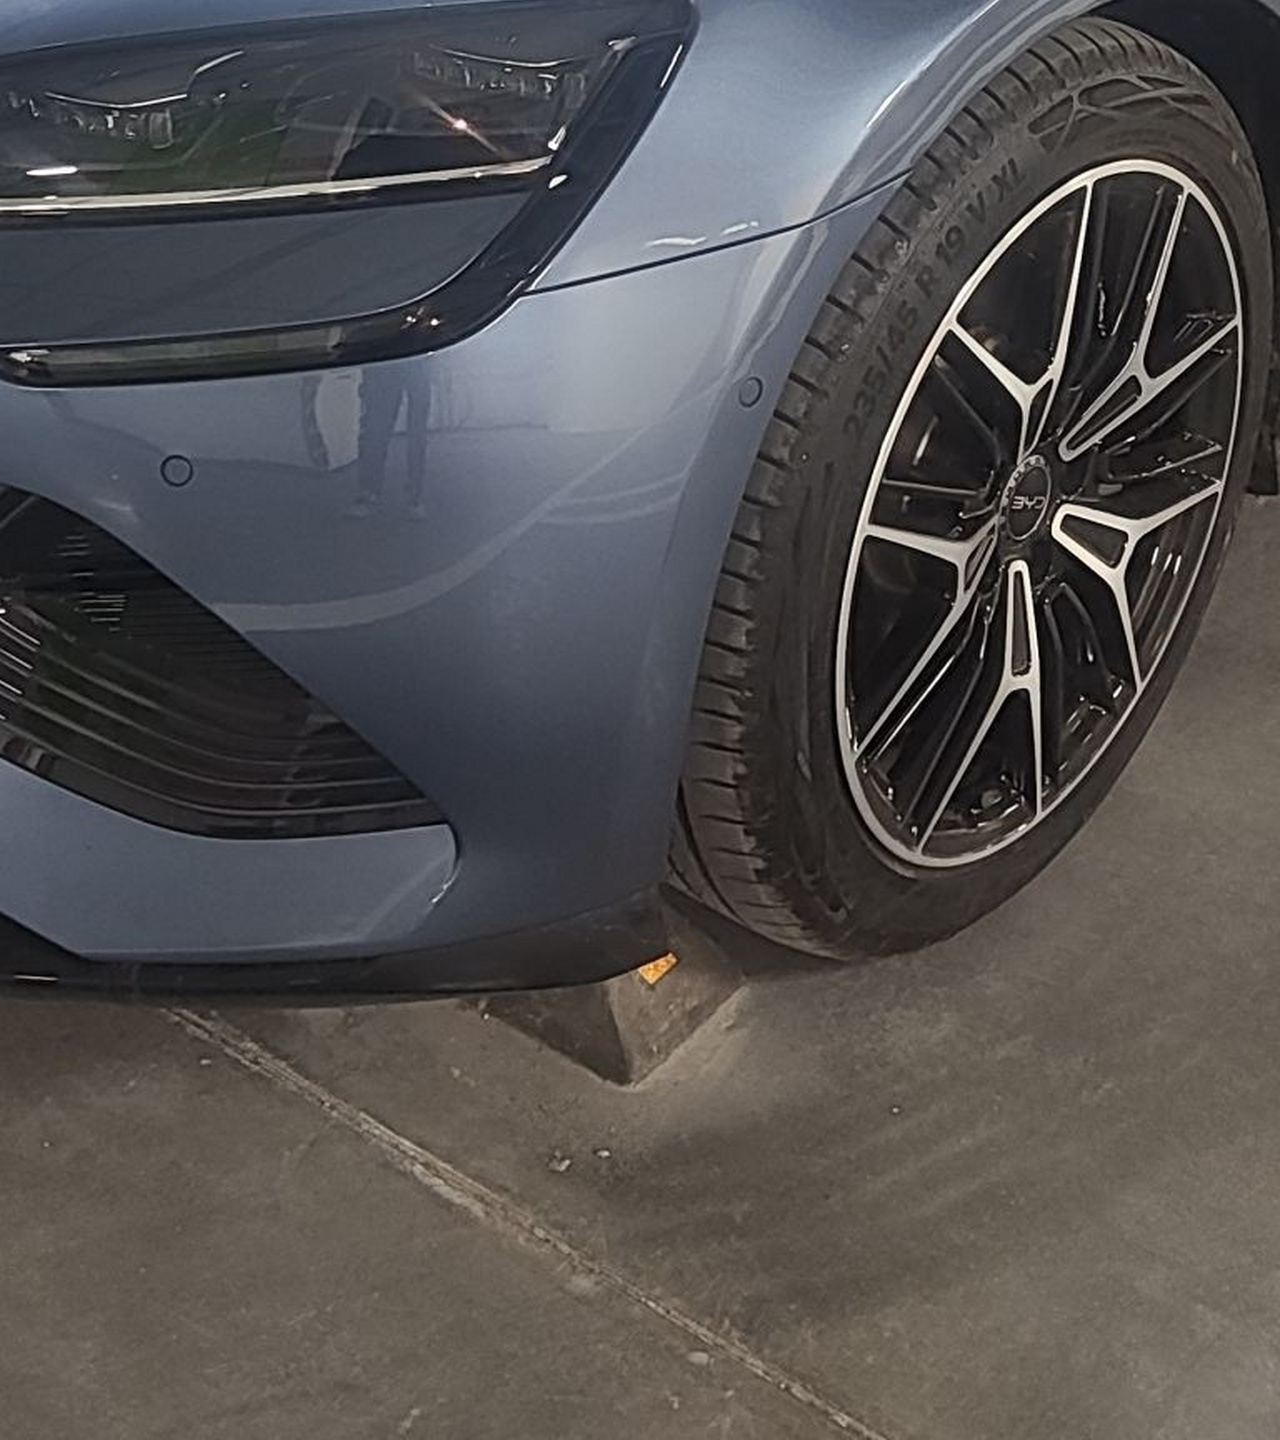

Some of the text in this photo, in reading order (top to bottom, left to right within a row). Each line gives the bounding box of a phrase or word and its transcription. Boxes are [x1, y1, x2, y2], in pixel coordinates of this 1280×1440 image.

[842, 299, 920, 441] 235/45
[935, 224, 966, 266] 19
[966, 189, 987, 225] V
[1011, 495, 1047, 510] BYD
